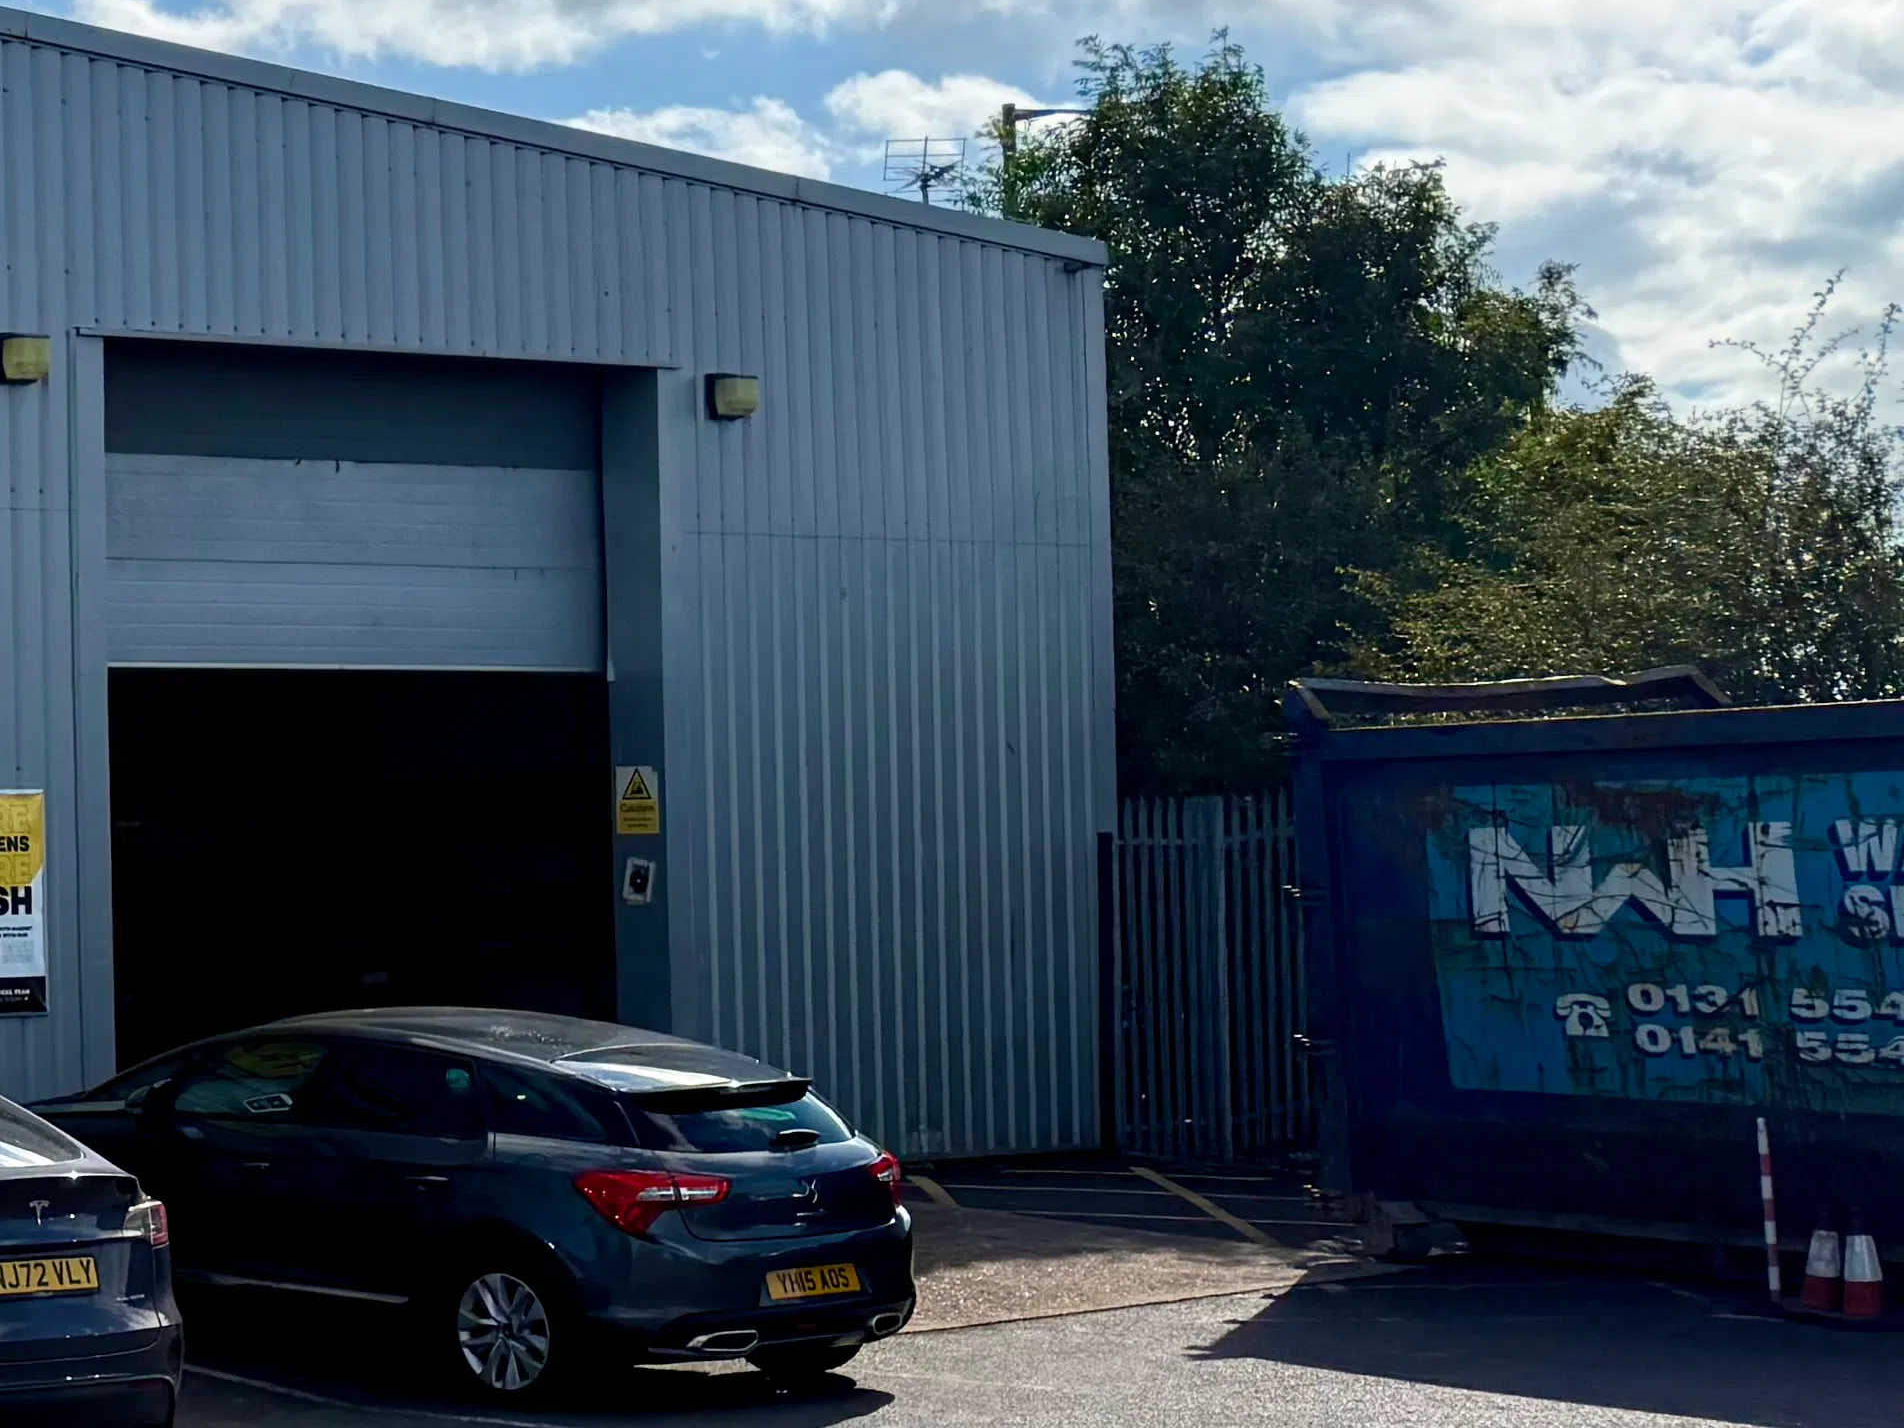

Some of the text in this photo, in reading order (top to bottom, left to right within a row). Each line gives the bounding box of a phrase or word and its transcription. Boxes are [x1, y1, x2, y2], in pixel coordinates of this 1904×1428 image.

[1833, 817, 1904, 873] W
[1627, 983, 1761, 1017] 0131
[1635, 1024, 1763, 1059] 0141
[52, 1259, 91, 1285] VLY
[776, 1267, 850, 1293] YH15 AOS
